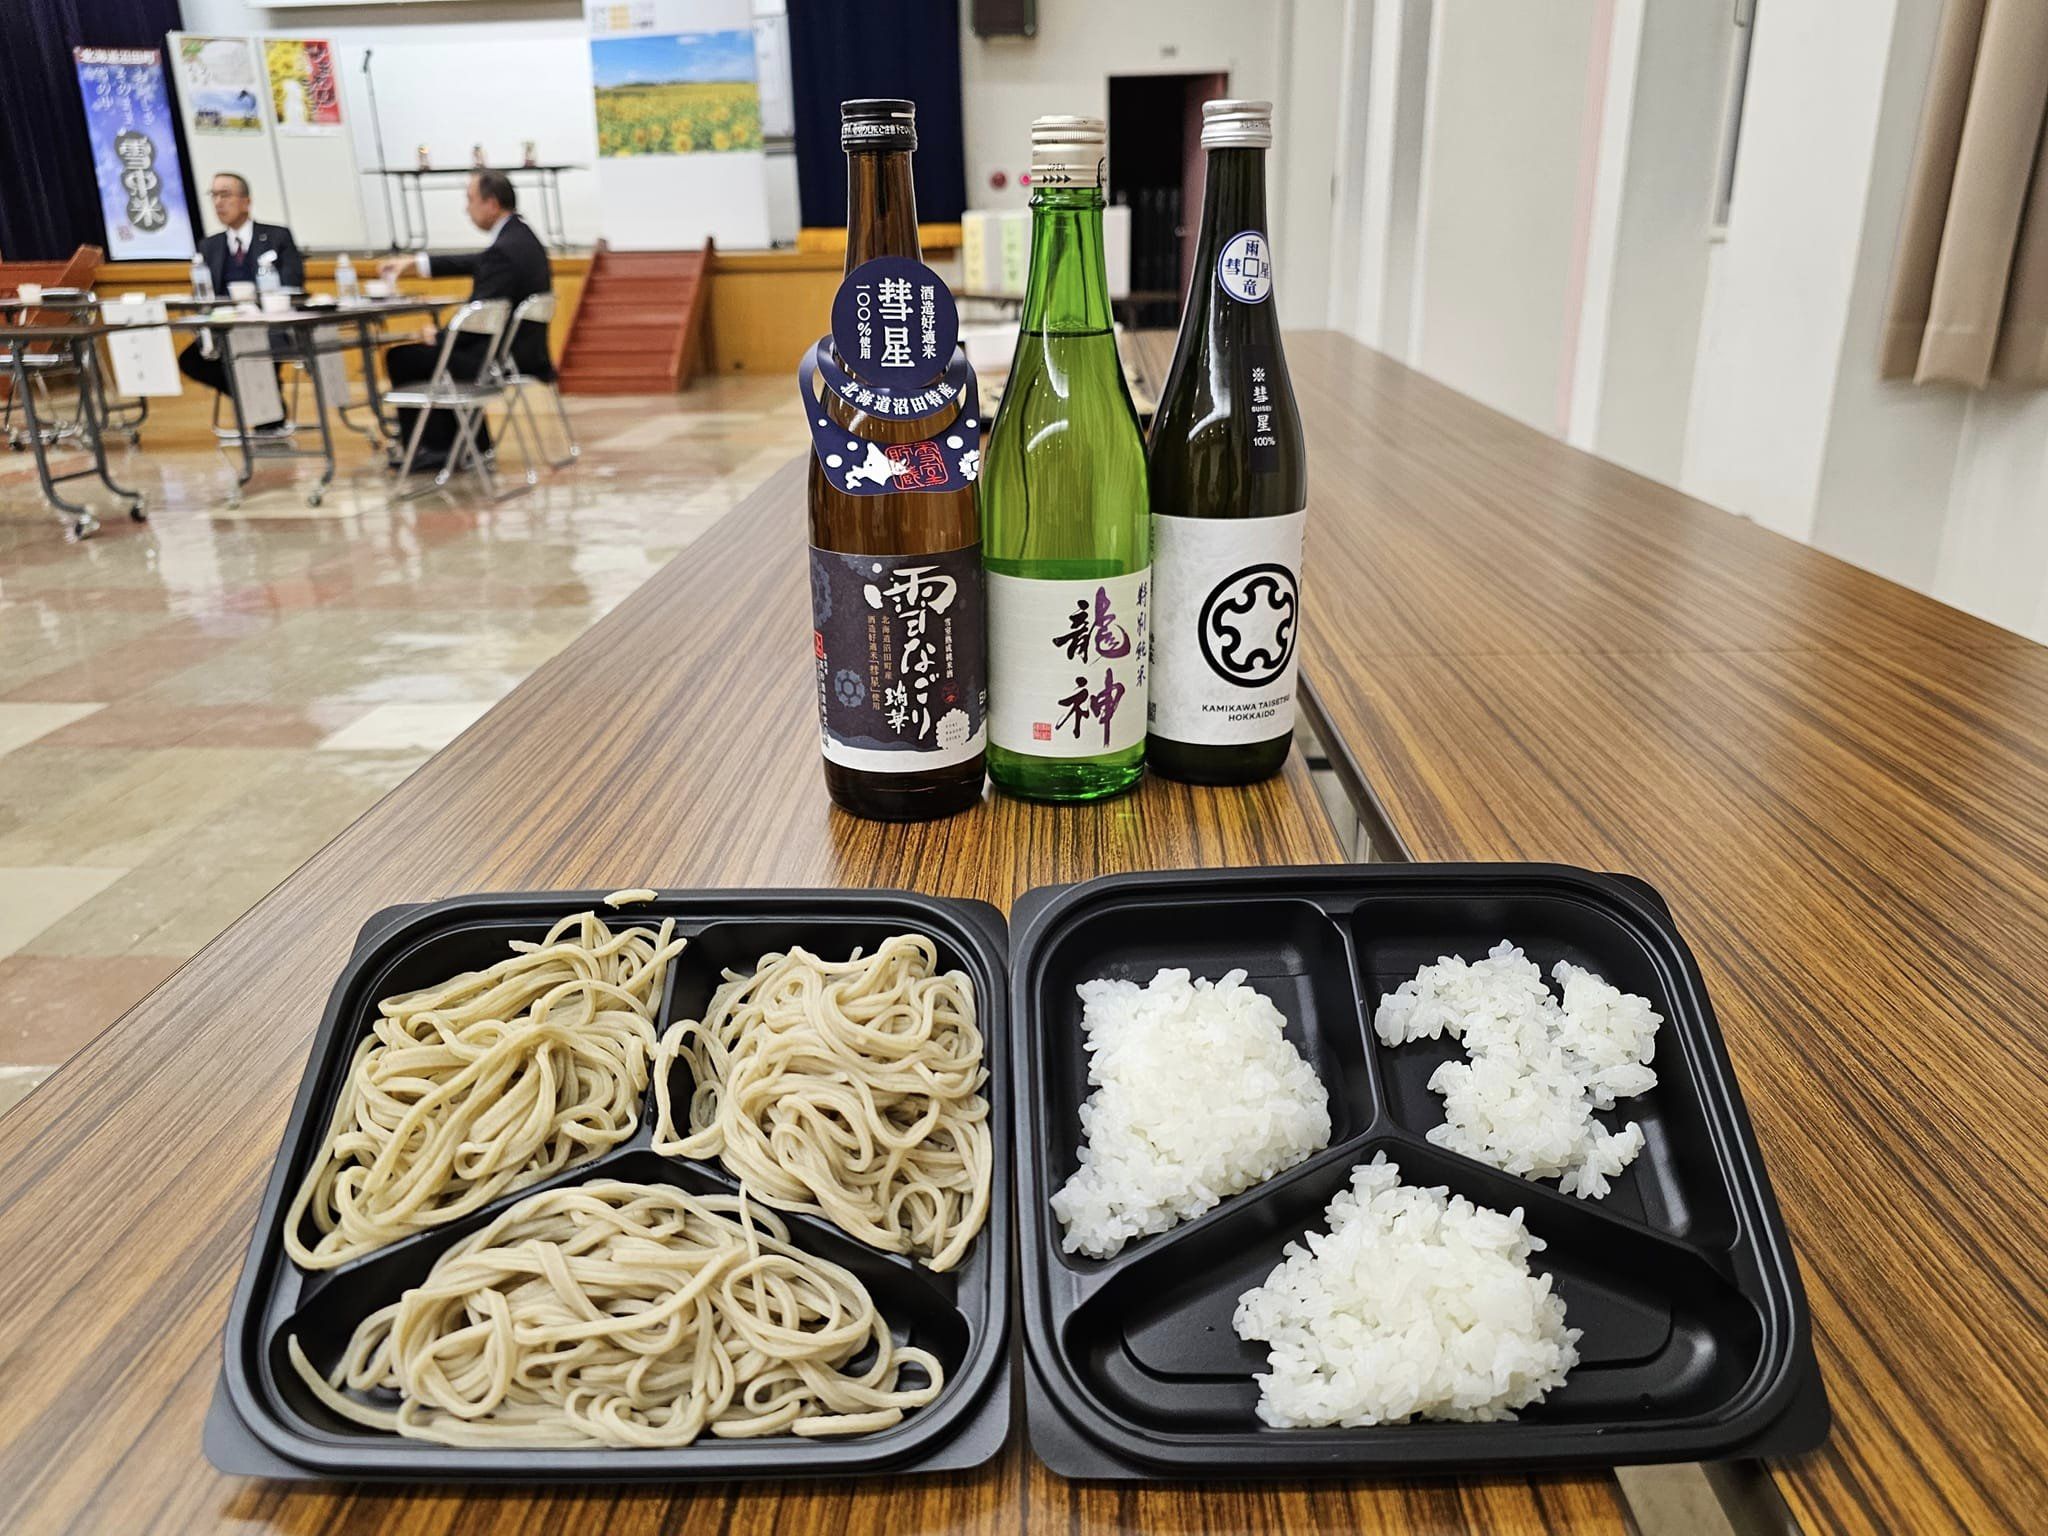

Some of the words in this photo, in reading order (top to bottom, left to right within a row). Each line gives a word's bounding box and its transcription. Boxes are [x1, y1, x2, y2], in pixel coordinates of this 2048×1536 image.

[117, 136, 166, 228] 雪中米
[877, 277, 916, 368] 彗星
[920, 284, 937, 360] 酒造好適米
[840, 381, 957, 416] 北海道沼田特産
[1253, 437, 1276, 447] 100%
[1052, 585, 1132, 749] 龍神
[1201, 703, 1257, 712] KAMIKAWA
[1228, 709, 1275, 722] HOKKAIDO
